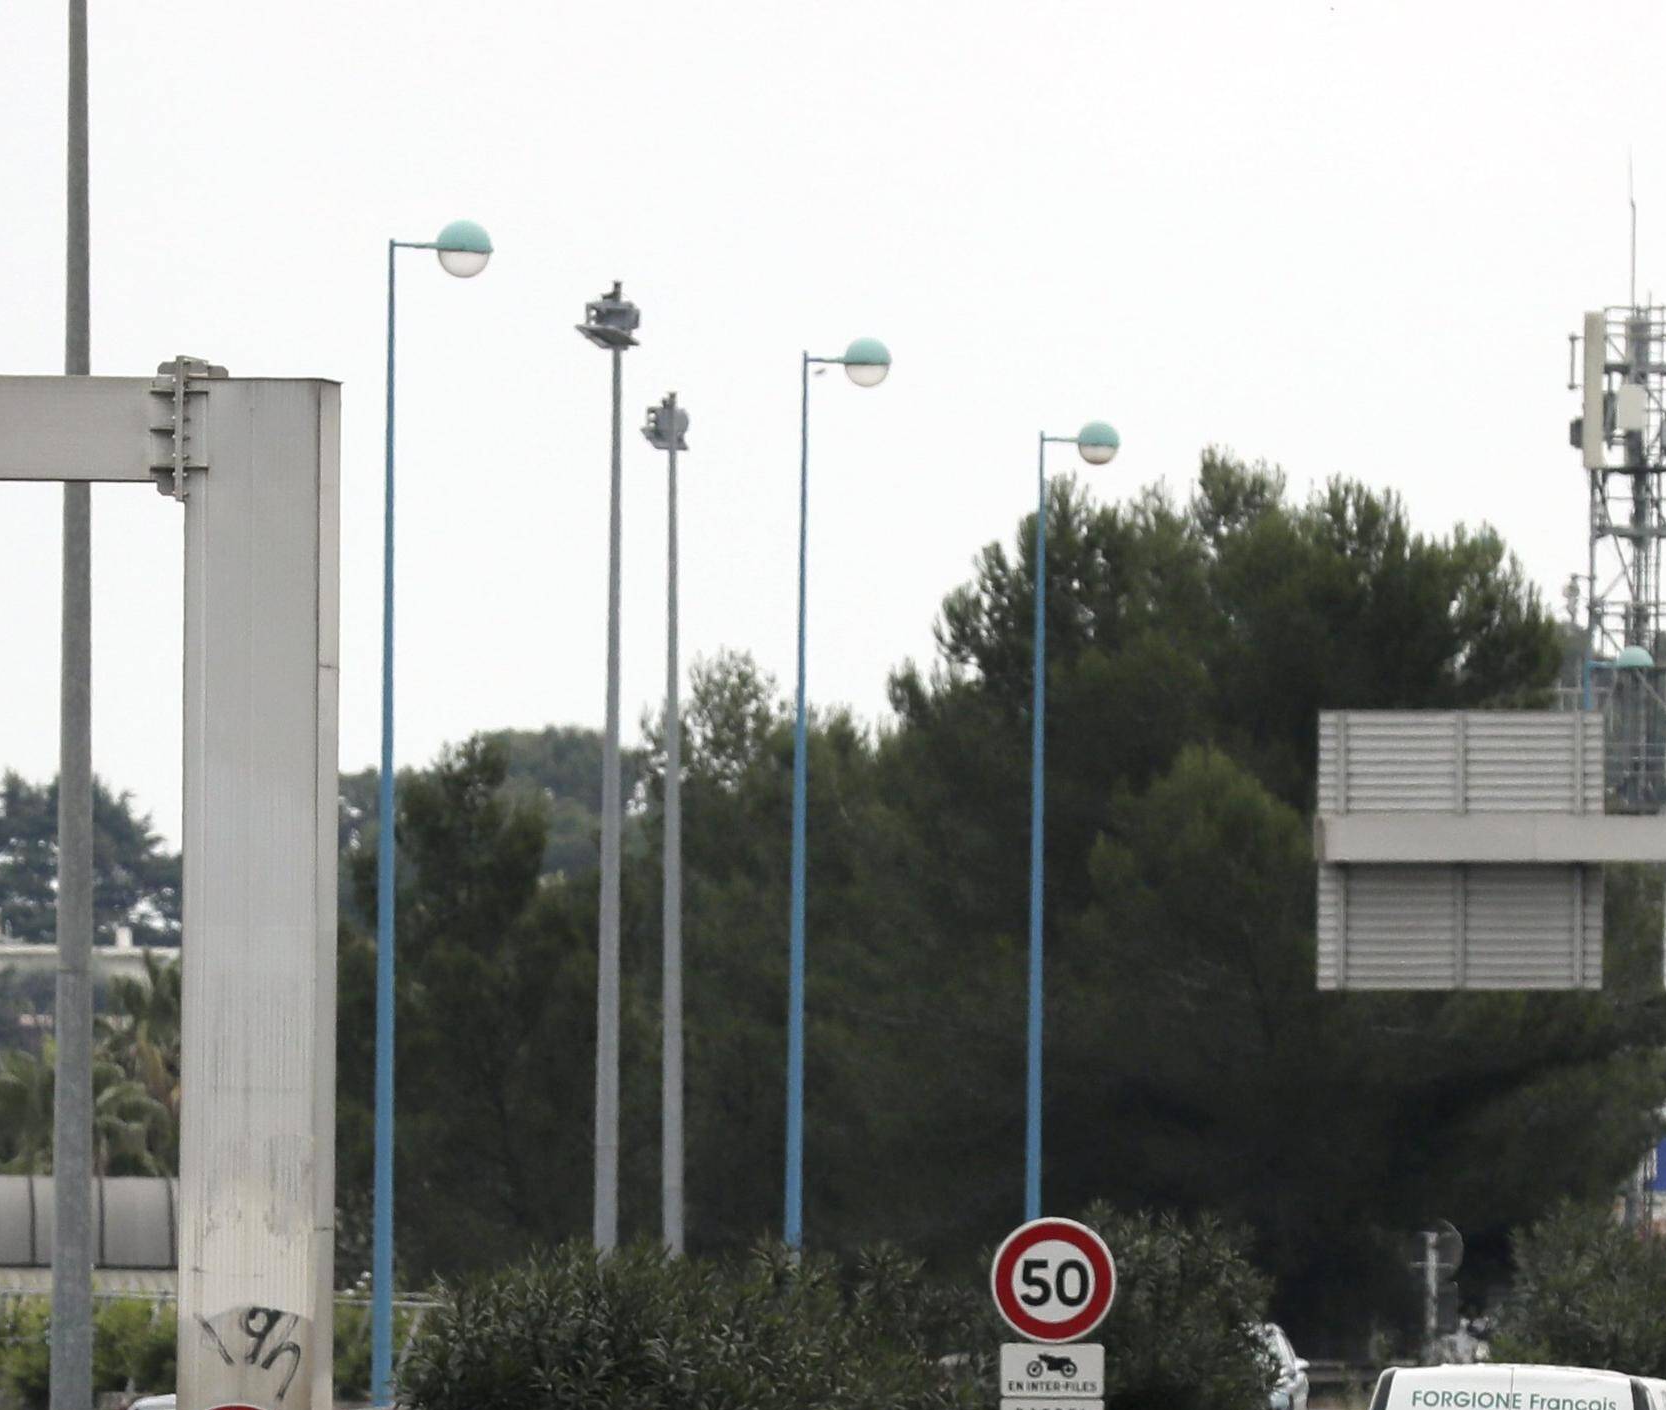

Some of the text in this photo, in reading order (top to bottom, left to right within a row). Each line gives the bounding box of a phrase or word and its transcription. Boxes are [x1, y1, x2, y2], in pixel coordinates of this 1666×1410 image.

[1020, 1259, 1089, 1307] 50
[1008, 1380, 1098, 1392] EN INTER-FILES
[1411, 1390, 1523, 1410] FORGIONE
